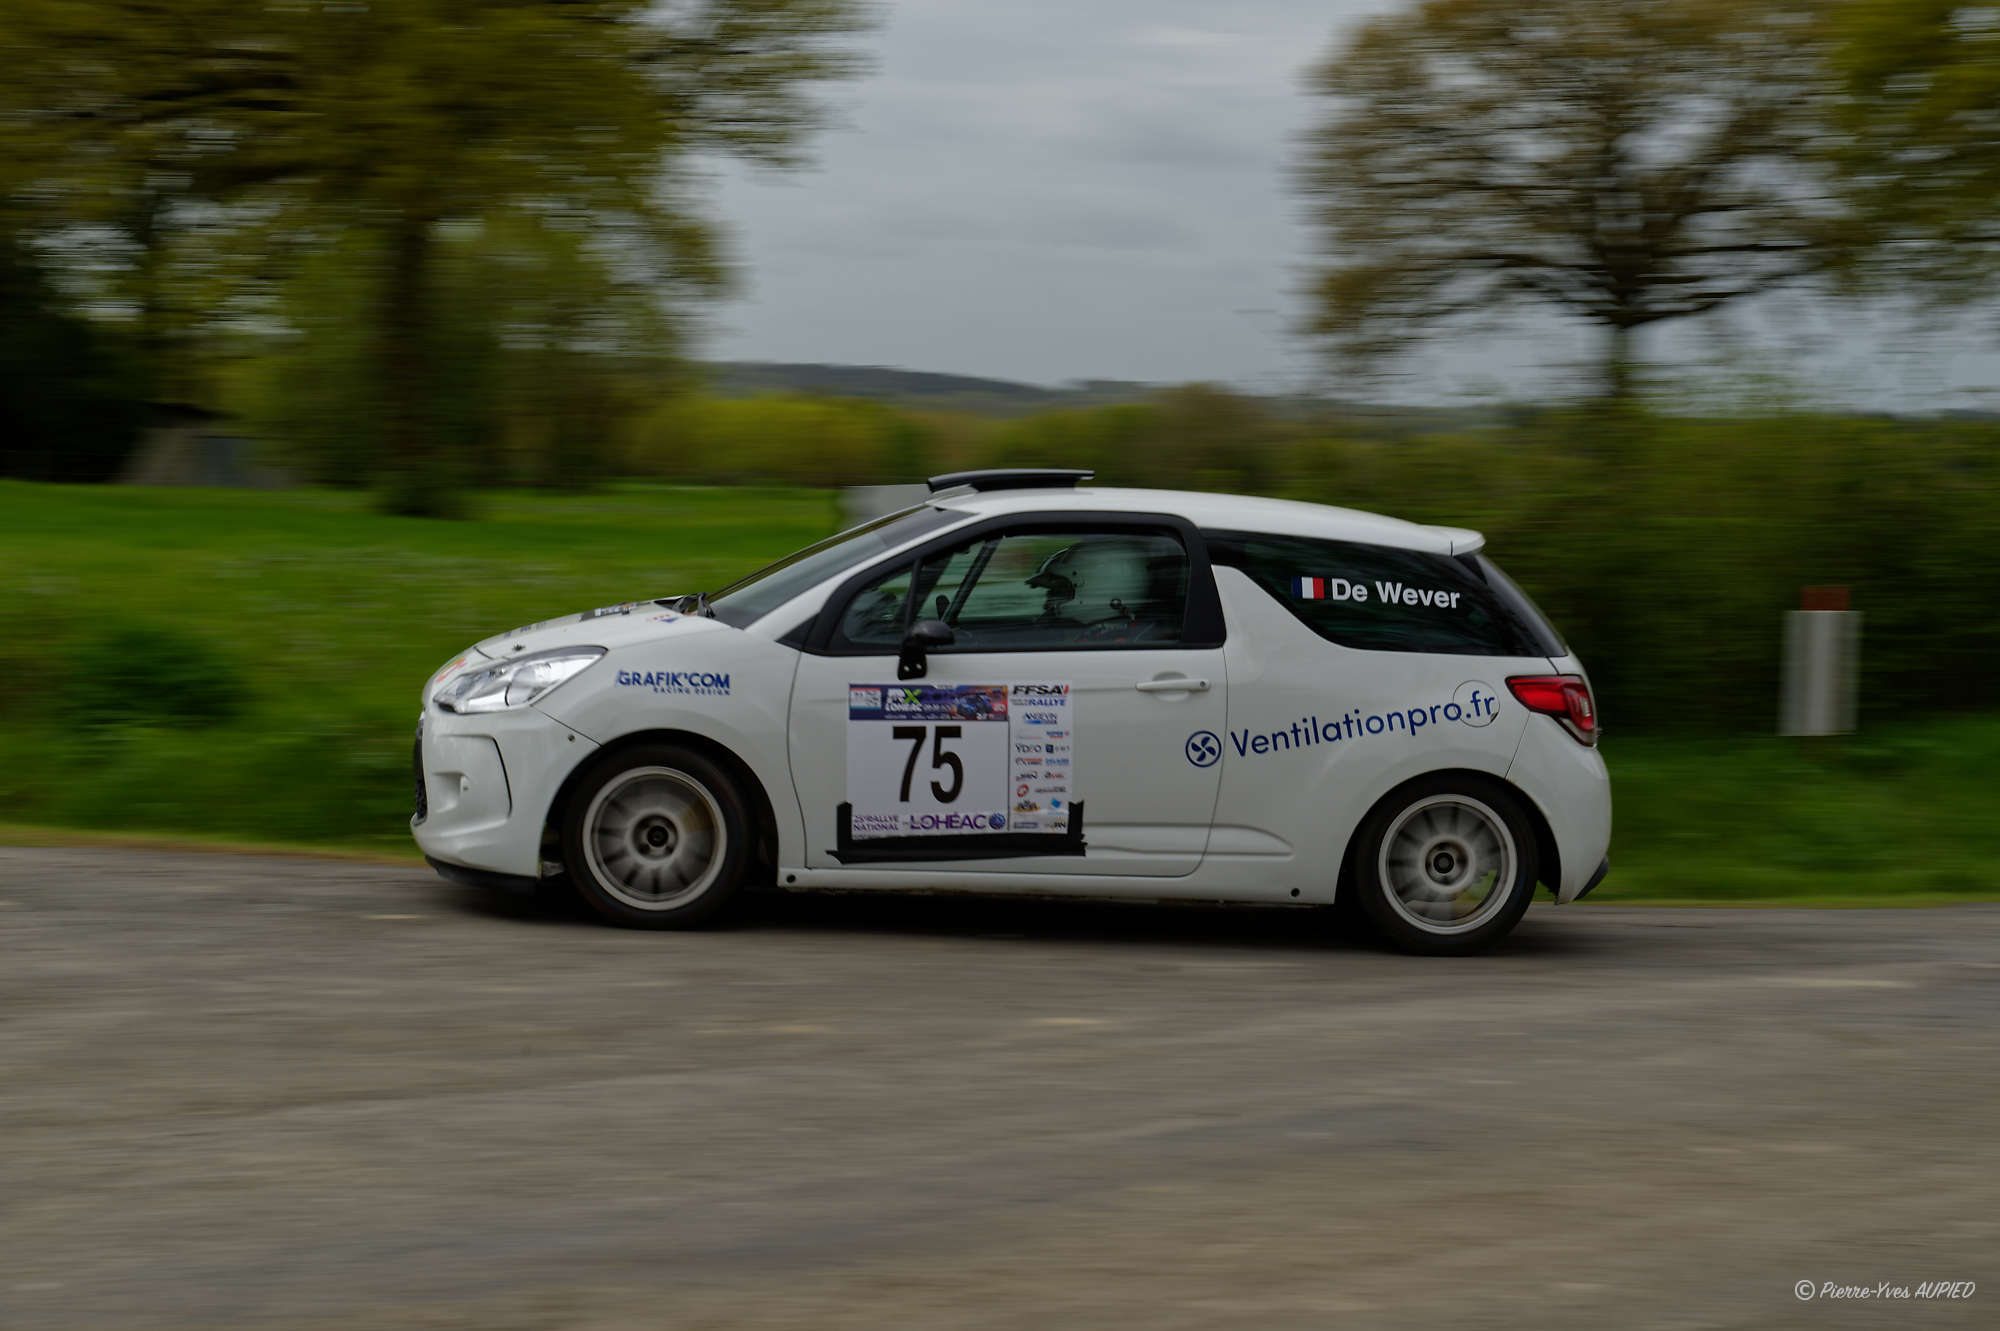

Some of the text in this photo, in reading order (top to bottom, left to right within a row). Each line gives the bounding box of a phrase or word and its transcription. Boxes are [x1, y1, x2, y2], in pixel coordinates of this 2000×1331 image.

[1331, 578, 1462, 609] De Wever
[615, 670, 731, 688] GRAFIK'COM
[654, 686, 731, 696] RACING DESIGN
[1012, 685, 1065, 695] FFSA
[1028, 698, 1066, 706] RALLYE
[1230, 690, 1496, 757] Ventilationpro.fr
[892, 725, 964, 804] 75
[853, 823, 899, 832] NATIONAL
[909, 812, 987, 830] LOHÉAC
